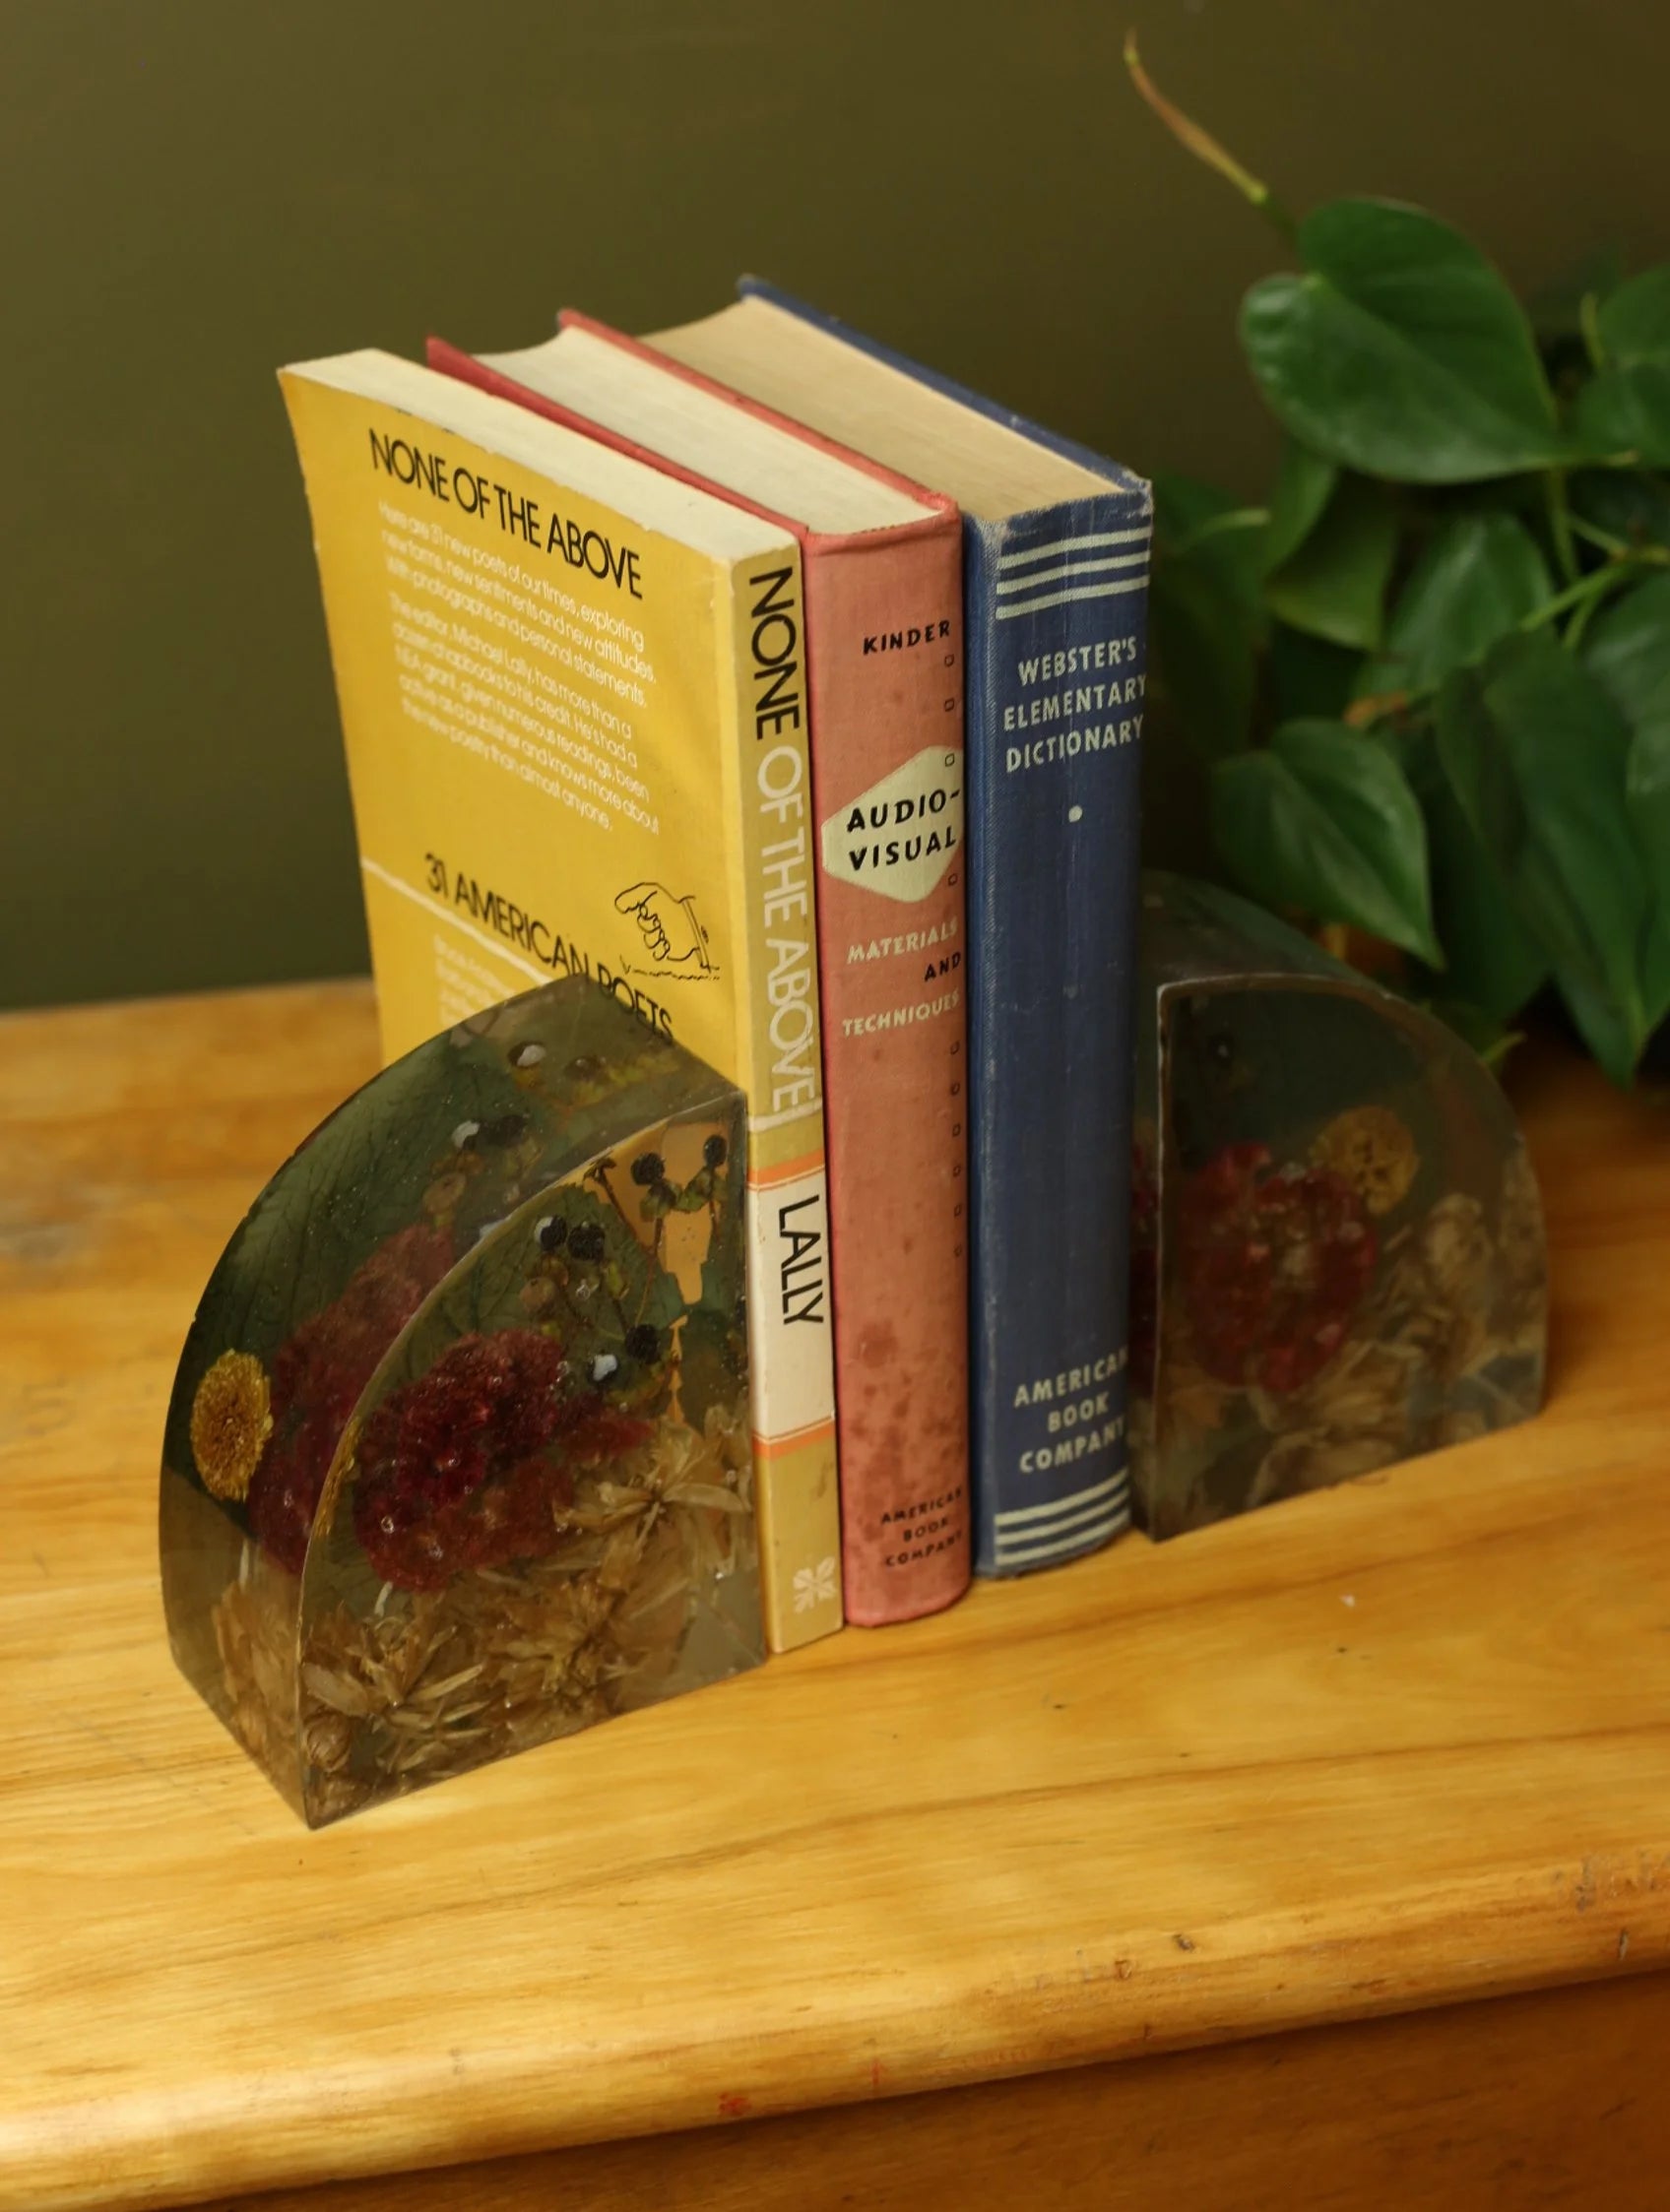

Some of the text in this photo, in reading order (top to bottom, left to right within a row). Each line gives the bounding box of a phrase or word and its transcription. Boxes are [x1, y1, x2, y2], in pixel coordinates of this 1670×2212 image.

[369, 427, 643, 600] NONE OF THE ABOVE
[565, 624, 593, 650] new
[581, 604, 644, 653] exploring
[863, 619, 951, 656] KINDER
[1018, 636, 1137, 686] WEBSTER'S
[1003, 672, 1147, 731] ELEMENTARY
[621, 722, 631, 740] a
[1005, 714, 1144, 773] DICTIONARY
[846, 789, 961, 833] AUDIO-
[748, 566, 816, 1112] NONE OF THE ABOVE
[849, 826, 957, 871] VISUAL
[425, 853, 449, 897] 31
[455, 872, 590, 978] AMERICAN
[847, 916, 958, 965] MATERIALS
[924, 951, 961, 982] AND
[842, 987, 960, 1038] TECHNIQUES
[779, 1194, 824, 1325] LALLY
[1013, 1344, 1128, 1409] AMERICAN
[1048, 1391, 1109, 1433] BOOK
[903, 1517, 948, 1543] BOOK
